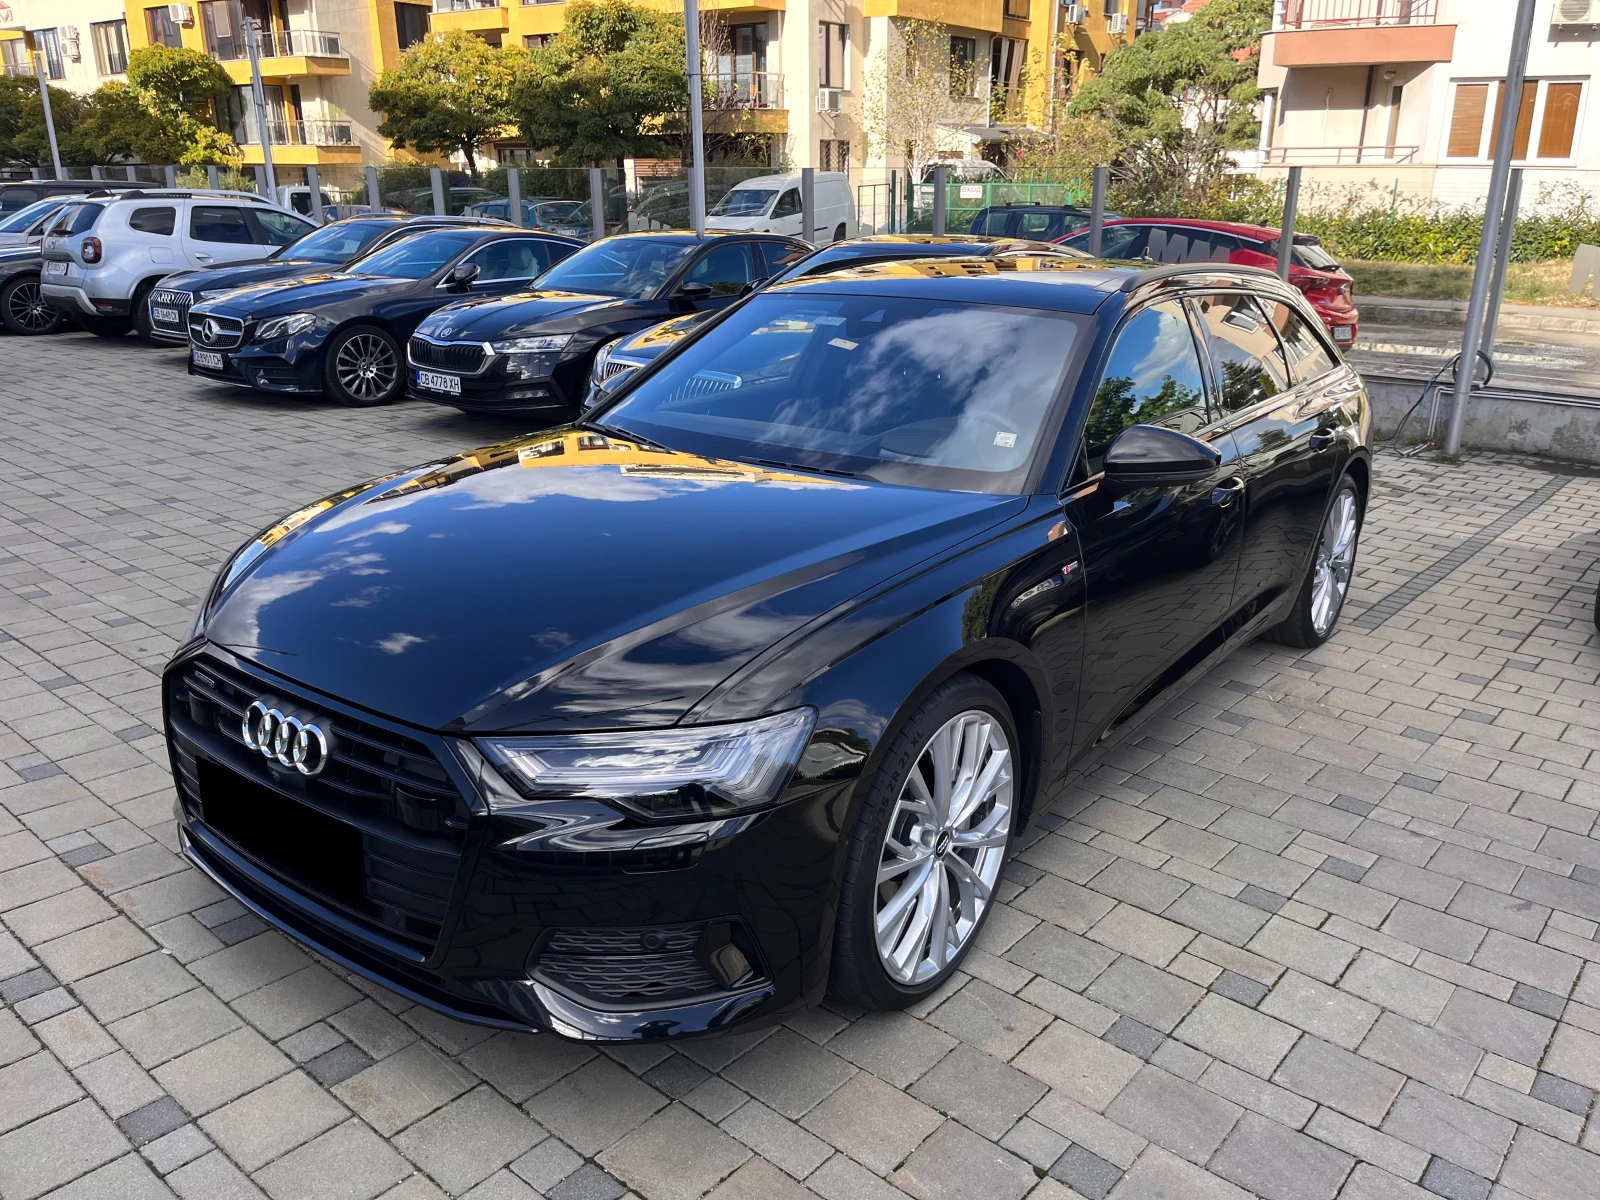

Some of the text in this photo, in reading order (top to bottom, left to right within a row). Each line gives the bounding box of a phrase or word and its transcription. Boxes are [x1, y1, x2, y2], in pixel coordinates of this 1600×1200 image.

[200, 352, 213, 365] 8901
[213, 354, 222, 366] CH
[421, 372, 430, 386] CB
[430, 375, 448, 389] 4778
[449, 377, 460, 391] XH
[887, 772, 901, 793] ZR
[898, 751, 910, 769] 21
[910, 731, 924, 749] XL
